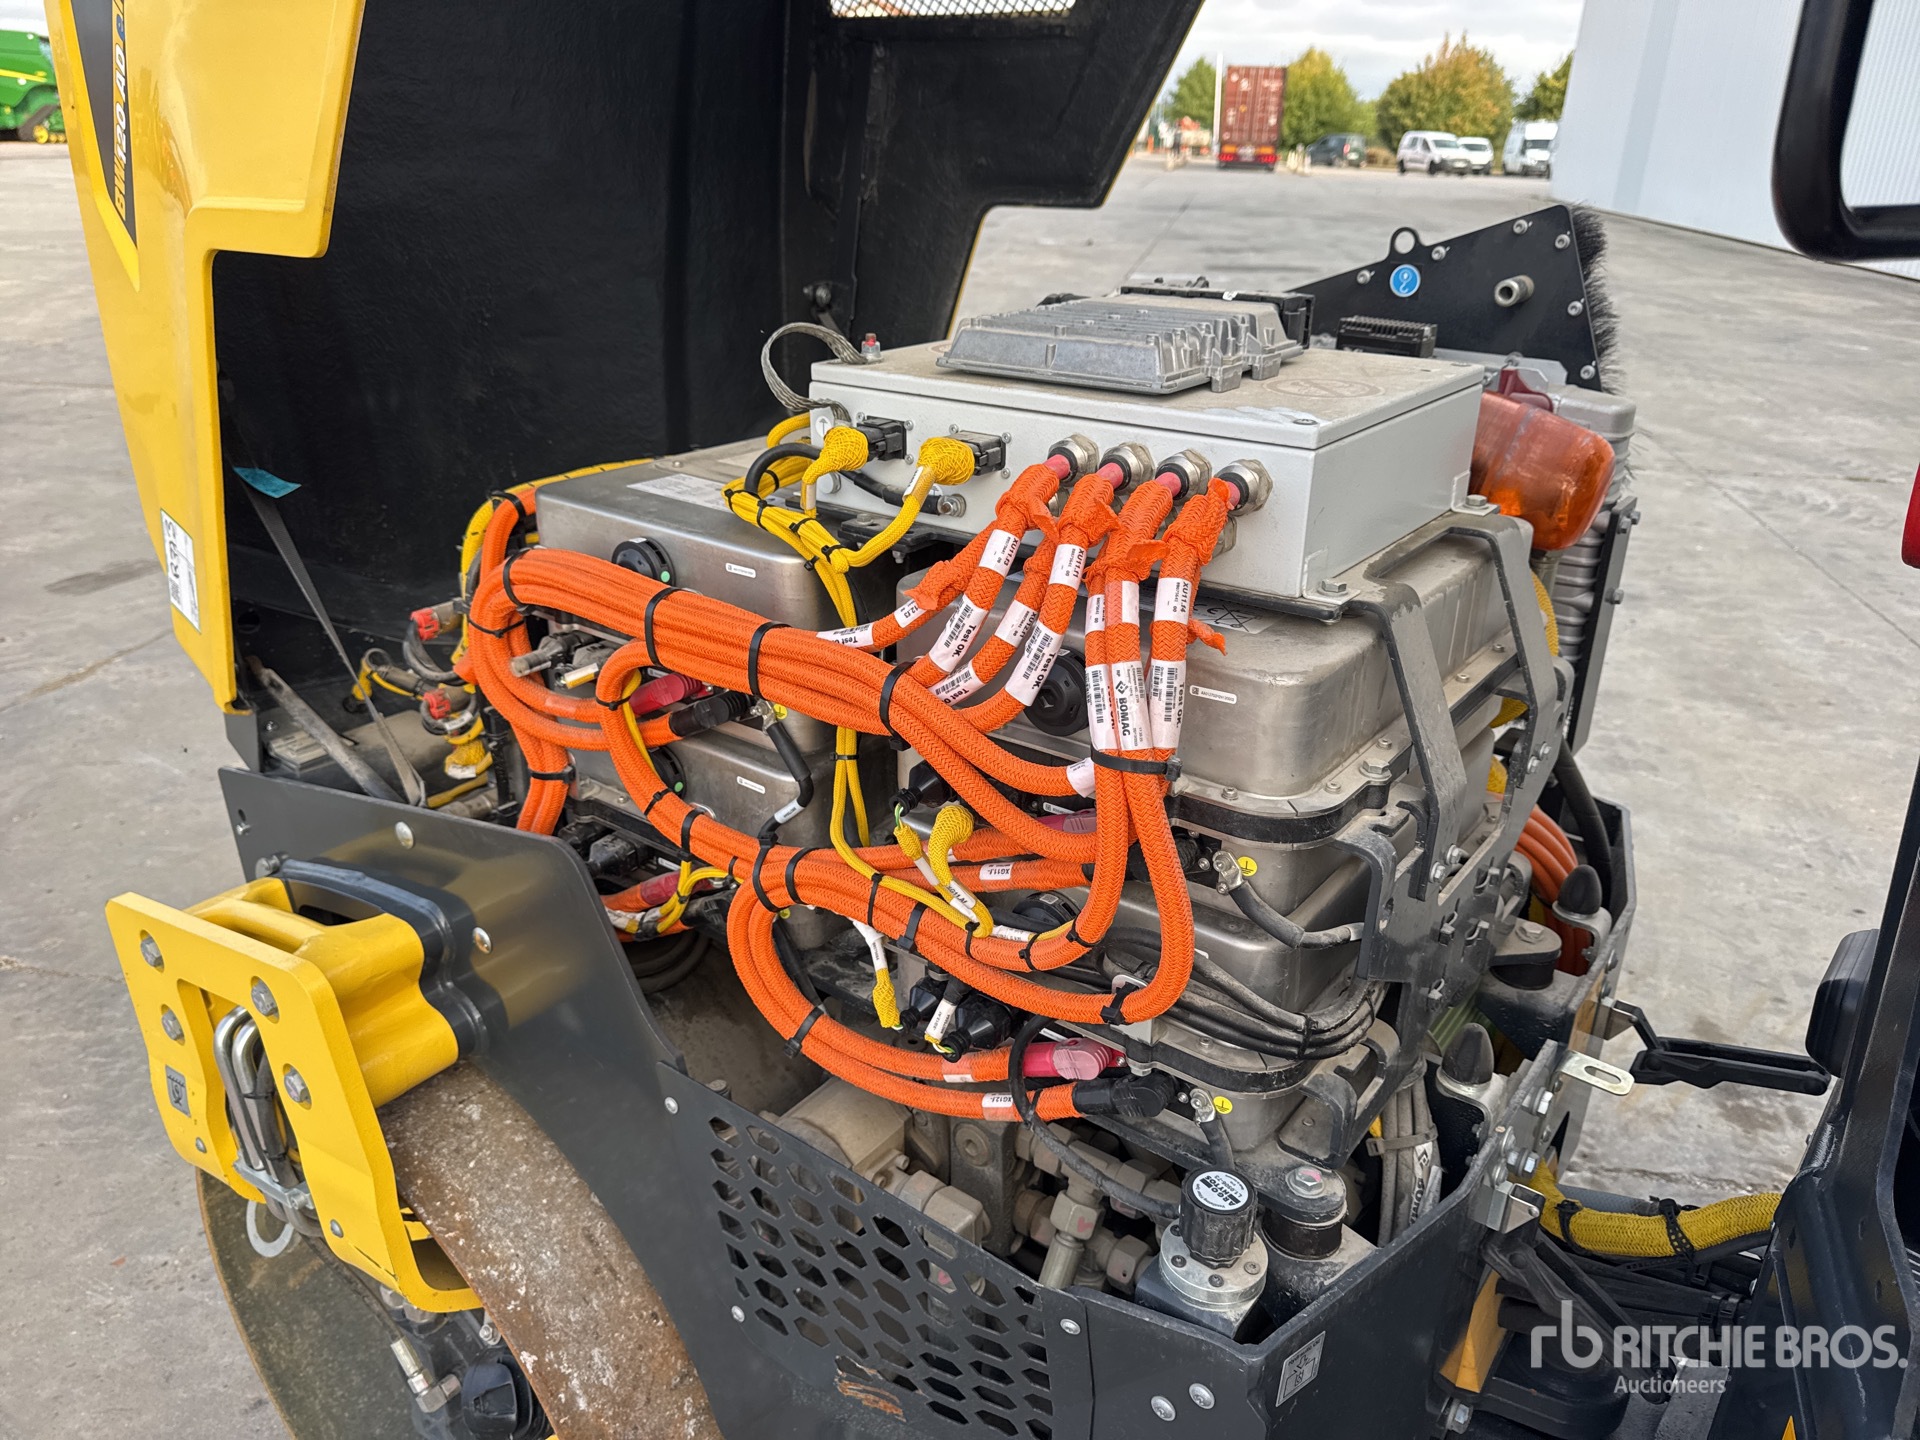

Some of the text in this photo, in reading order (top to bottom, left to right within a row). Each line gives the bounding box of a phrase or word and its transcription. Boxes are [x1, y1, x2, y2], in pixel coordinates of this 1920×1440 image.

[115, 43, 126, 102] AD
[1003, 538, 1019, 566] XU11.f3
[1073, 548, 1085, 578] XU11.f1
[1180, 582, 1189, 613] XU11.f4
[903, 605, 919, 619] 12.f3
[960, 624, 976, 643] Test
[951, 643, 965, 658] OK.
[1032, 652, 1056, 690] Test OK.
[952, 688, 969, 699] Test
[1119, 697, 1131, 736] BOMAG
[1211, 1187, 1236, 1206] ARGO
